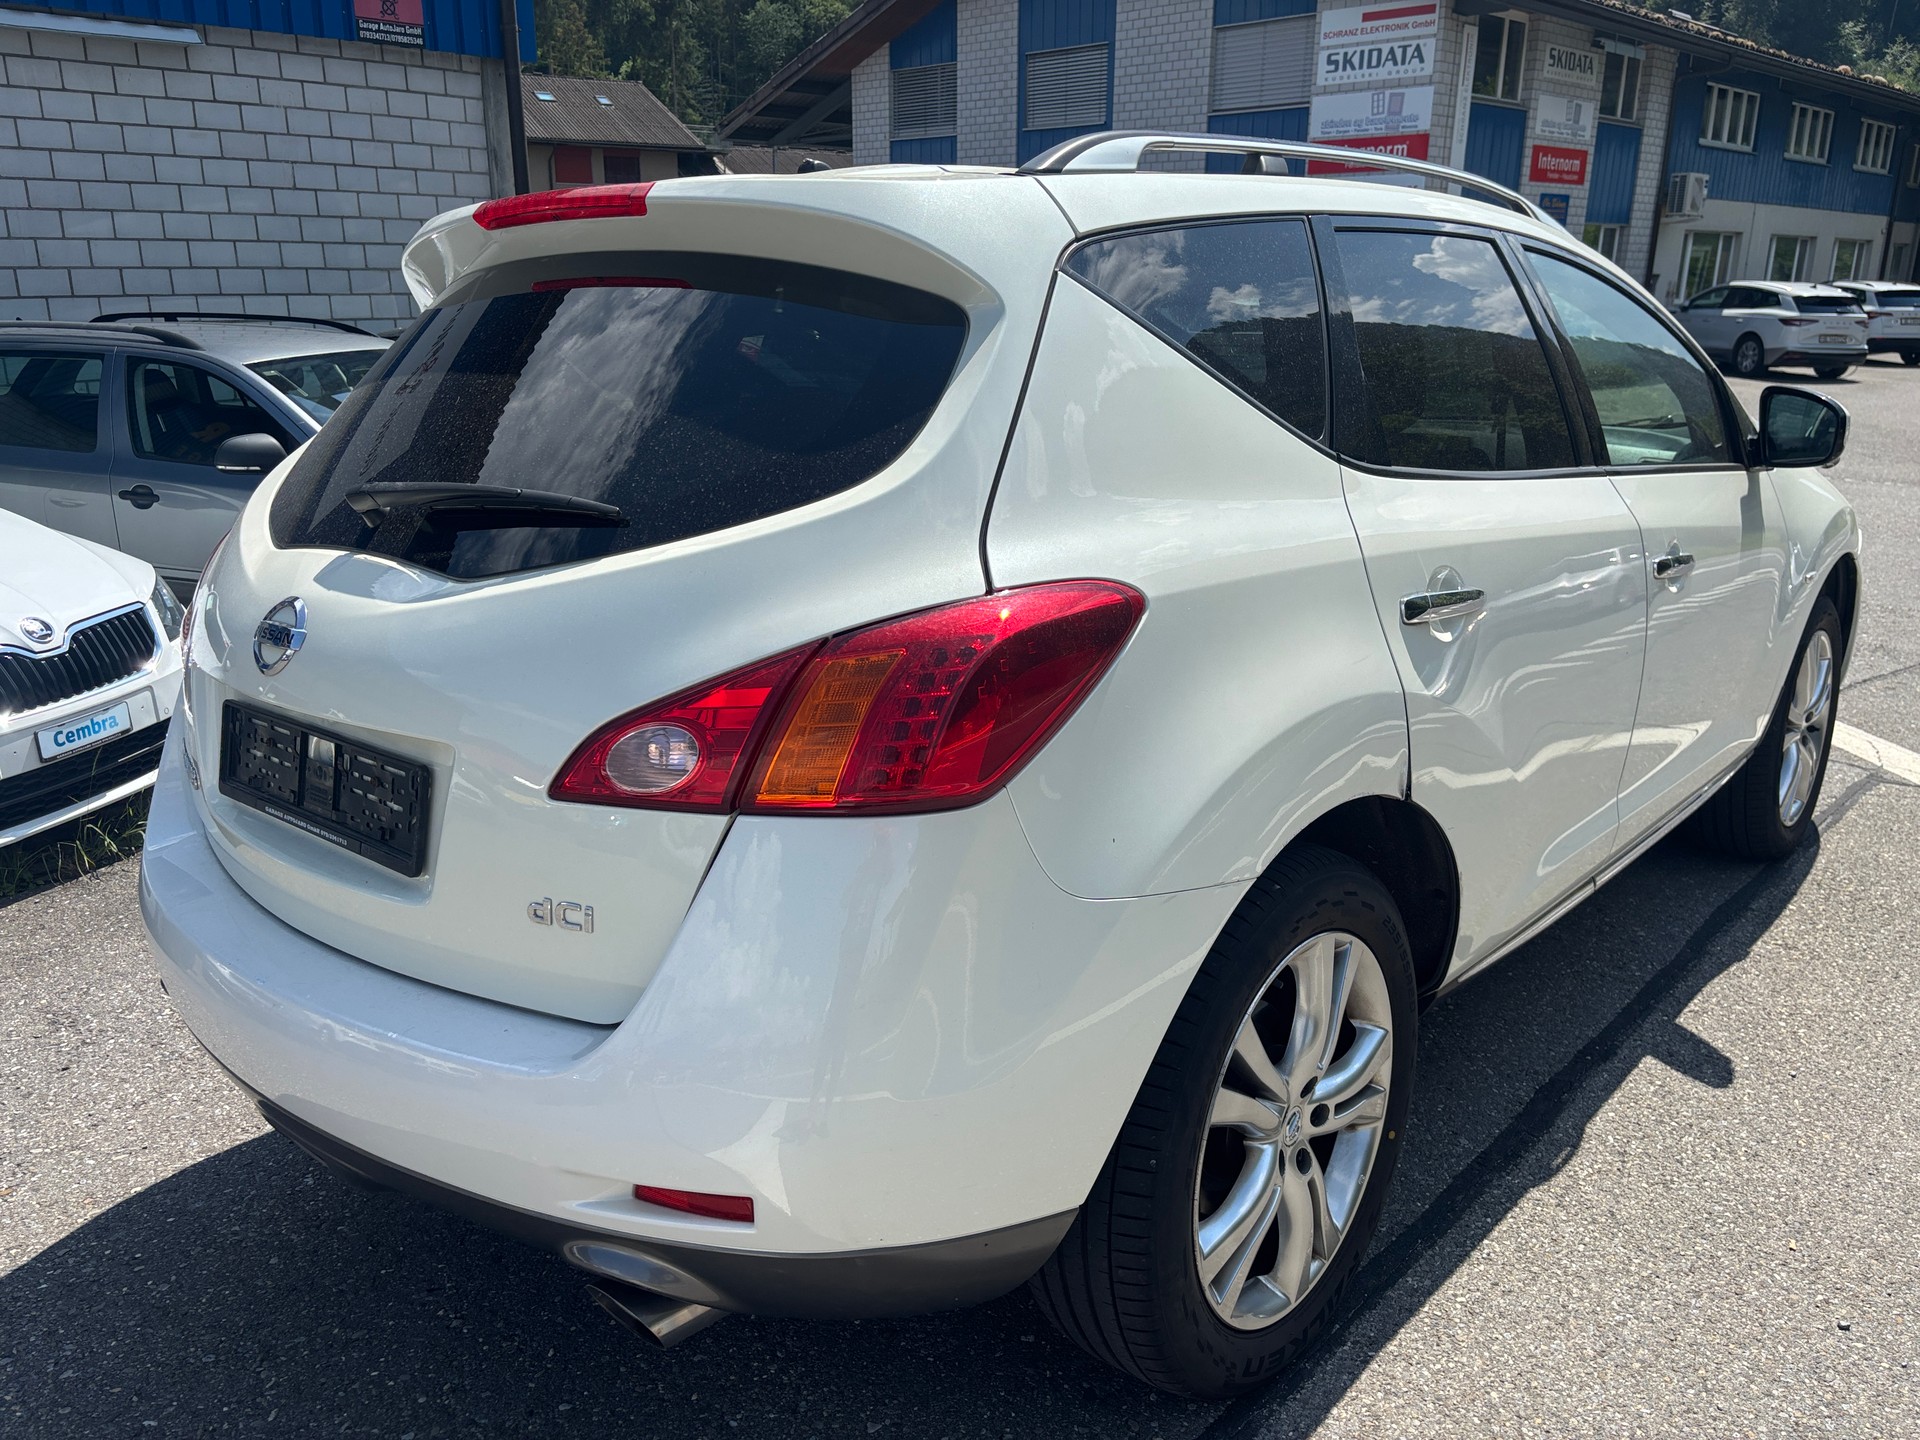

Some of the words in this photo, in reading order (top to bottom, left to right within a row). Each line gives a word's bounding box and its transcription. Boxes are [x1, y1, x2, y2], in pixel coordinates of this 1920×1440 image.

[358, 19, 379, 31] Garage
[405, 25, 422, 35] GmbH
[1323, 28, 1359, 40] SCHRANZ
[1360, 22, 1410, 35] ELEKTRONIK
[1412, 19, 1436, 30] GmbH
[1325, 43, 1425, 74] SKIDATA
[1548, 47, 1594, 75] SKIDATA
[1324, 71, 1379, 82] KUDELSKI
[1387, 66, 1425, 76] GROUP
[1538, 152, 1581, 172] Internorm
[53, 714, 119, 748] Cembra
[526, 896, 596, 935] dCi
